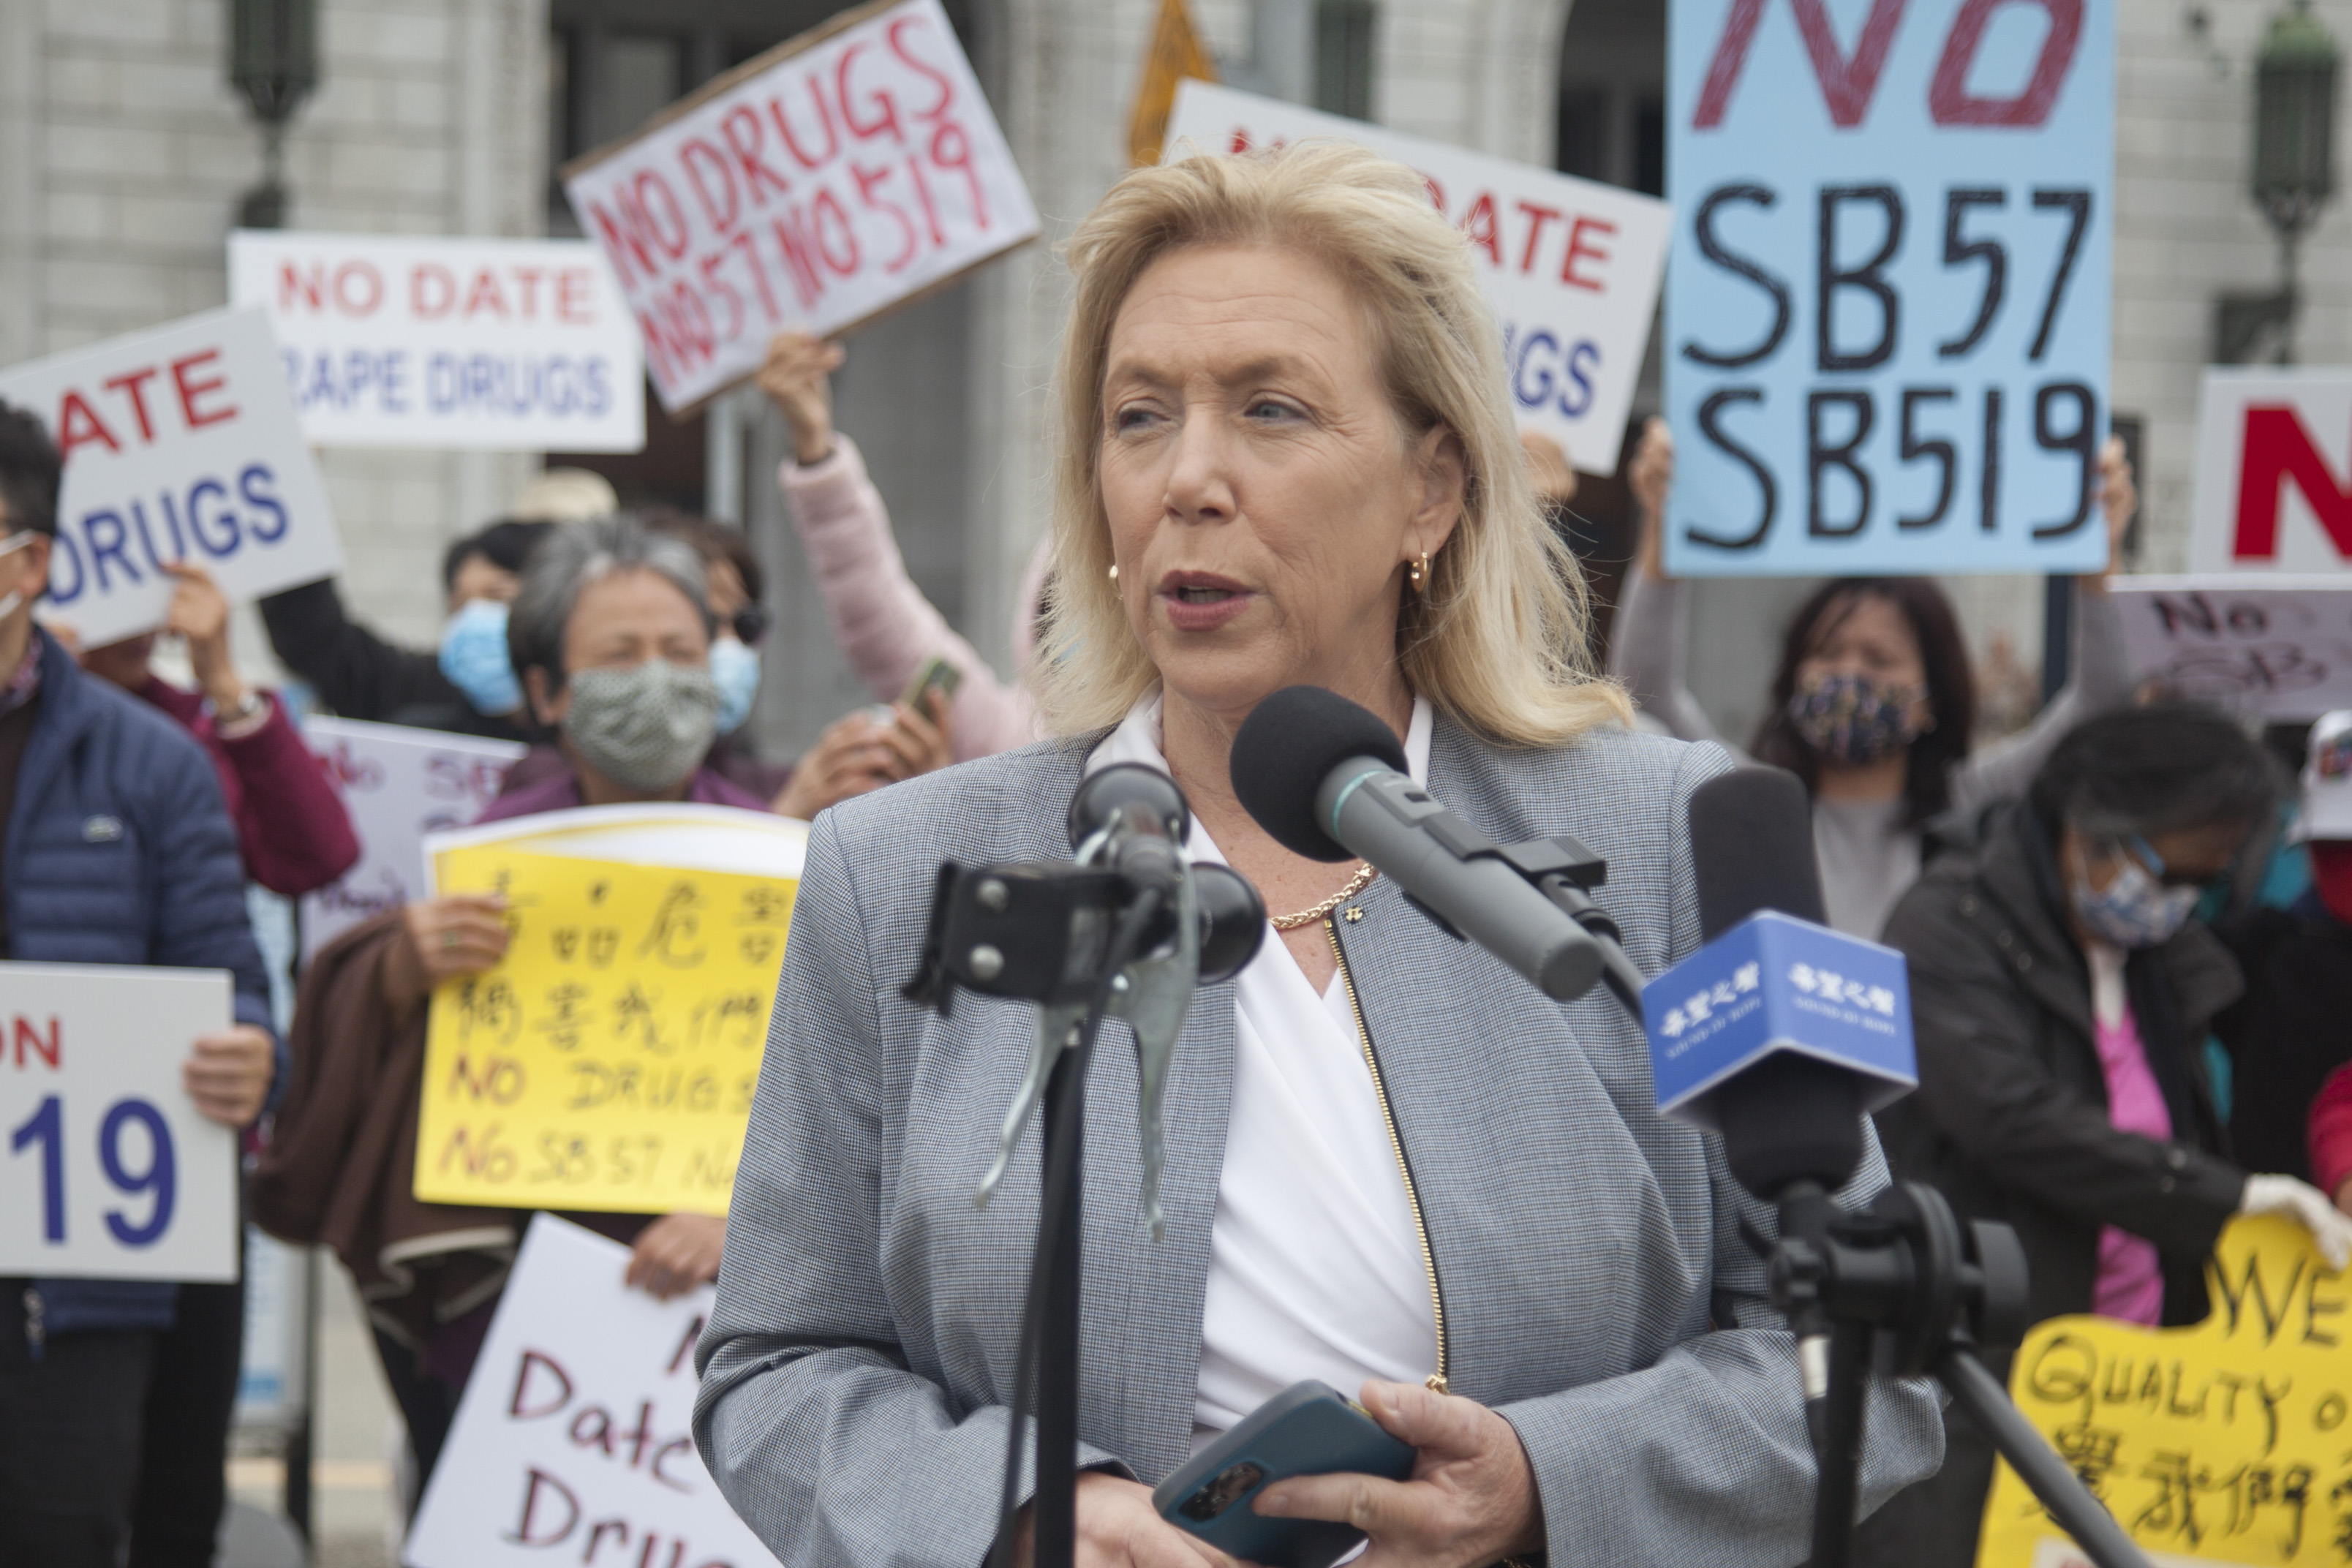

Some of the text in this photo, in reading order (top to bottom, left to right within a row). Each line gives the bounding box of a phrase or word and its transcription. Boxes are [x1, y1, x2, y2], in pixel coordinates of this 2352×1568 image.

[1691, 0, 2089, 131] NO
[589, 13, 957, 290] NO DRUGS
[277, 258, 599, 326] NO DATE
[428, 353, 613, 420] DRUGS
[1505, 324, 1602, 418] GS
[0, 1014, 61, 1070] N
[446, 1052, 529, 1108] NO
[499, 1466, 739, 1568] Dru
